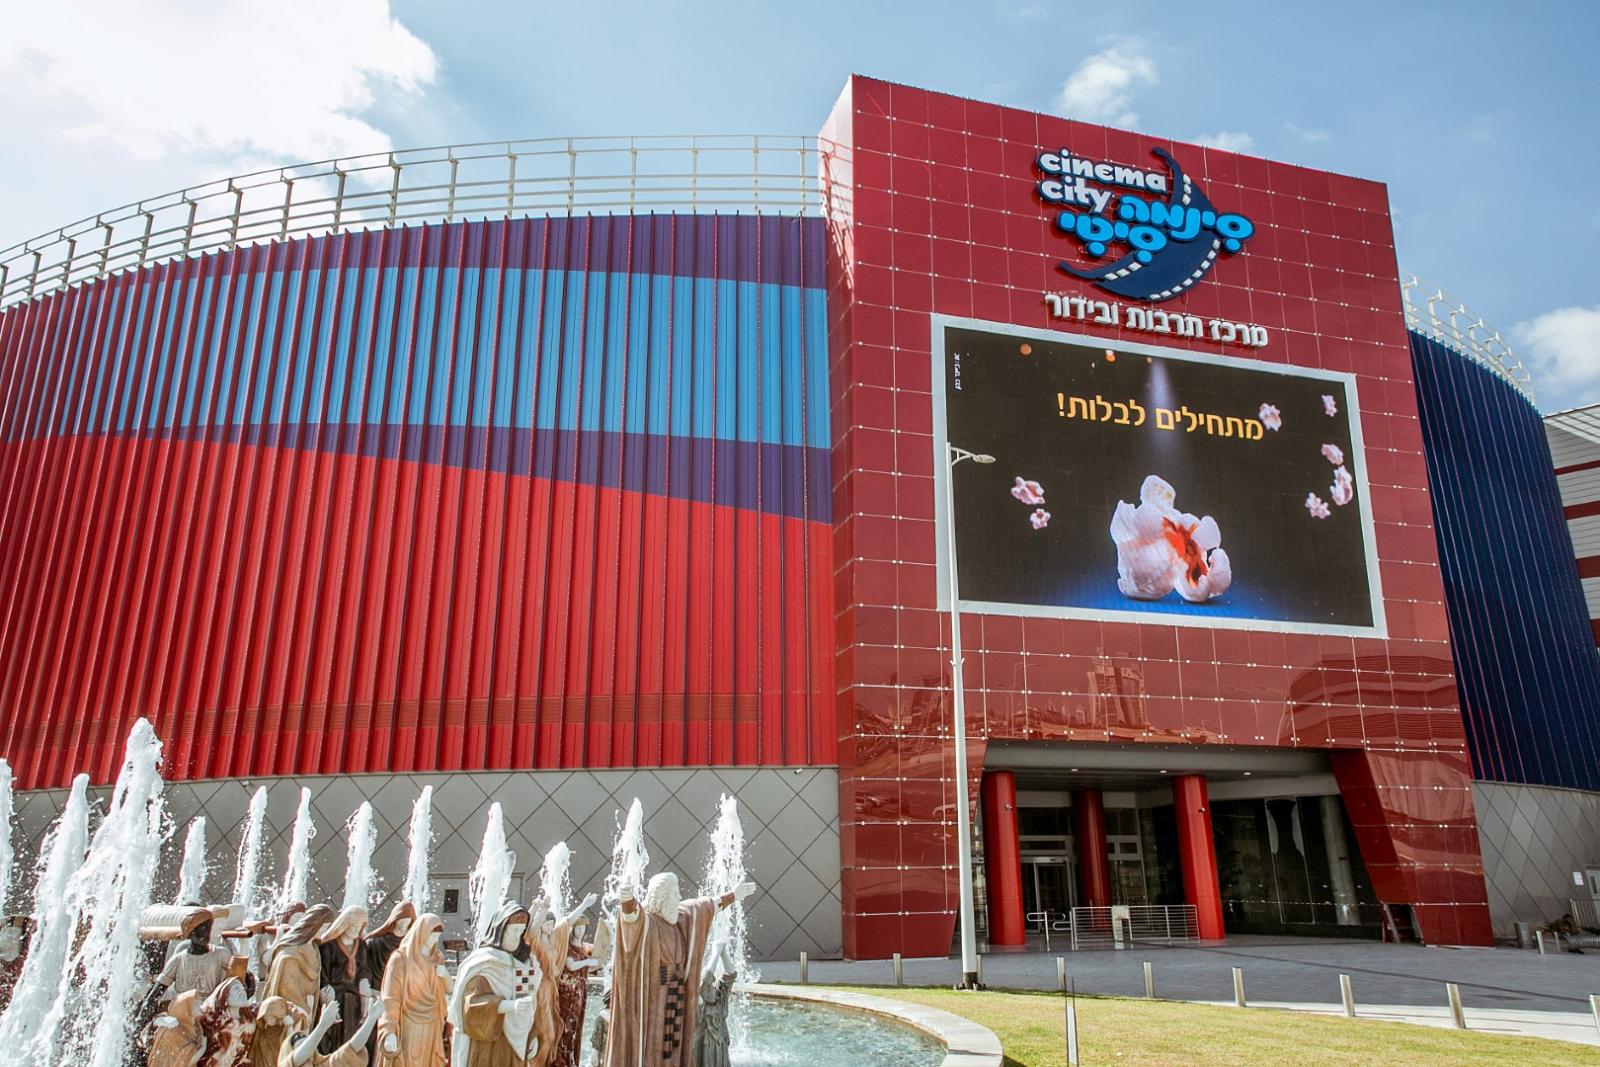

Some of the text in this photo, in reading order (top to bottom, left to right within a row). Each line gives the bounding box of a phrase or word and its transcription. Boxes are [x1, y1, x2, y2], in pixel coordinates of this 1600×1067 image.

[1040, 149, 1167, 193] cinema
[1040, 176, 1112, 213] city
[1060, 212, 1167, 264] סיטי
[1119, 196, 1254, 252] סינמה
[1045, 293, 1268, 346] מרכז תרבות ובידור
[1057, 392, 1264, 441] מתחילים לבלות!
